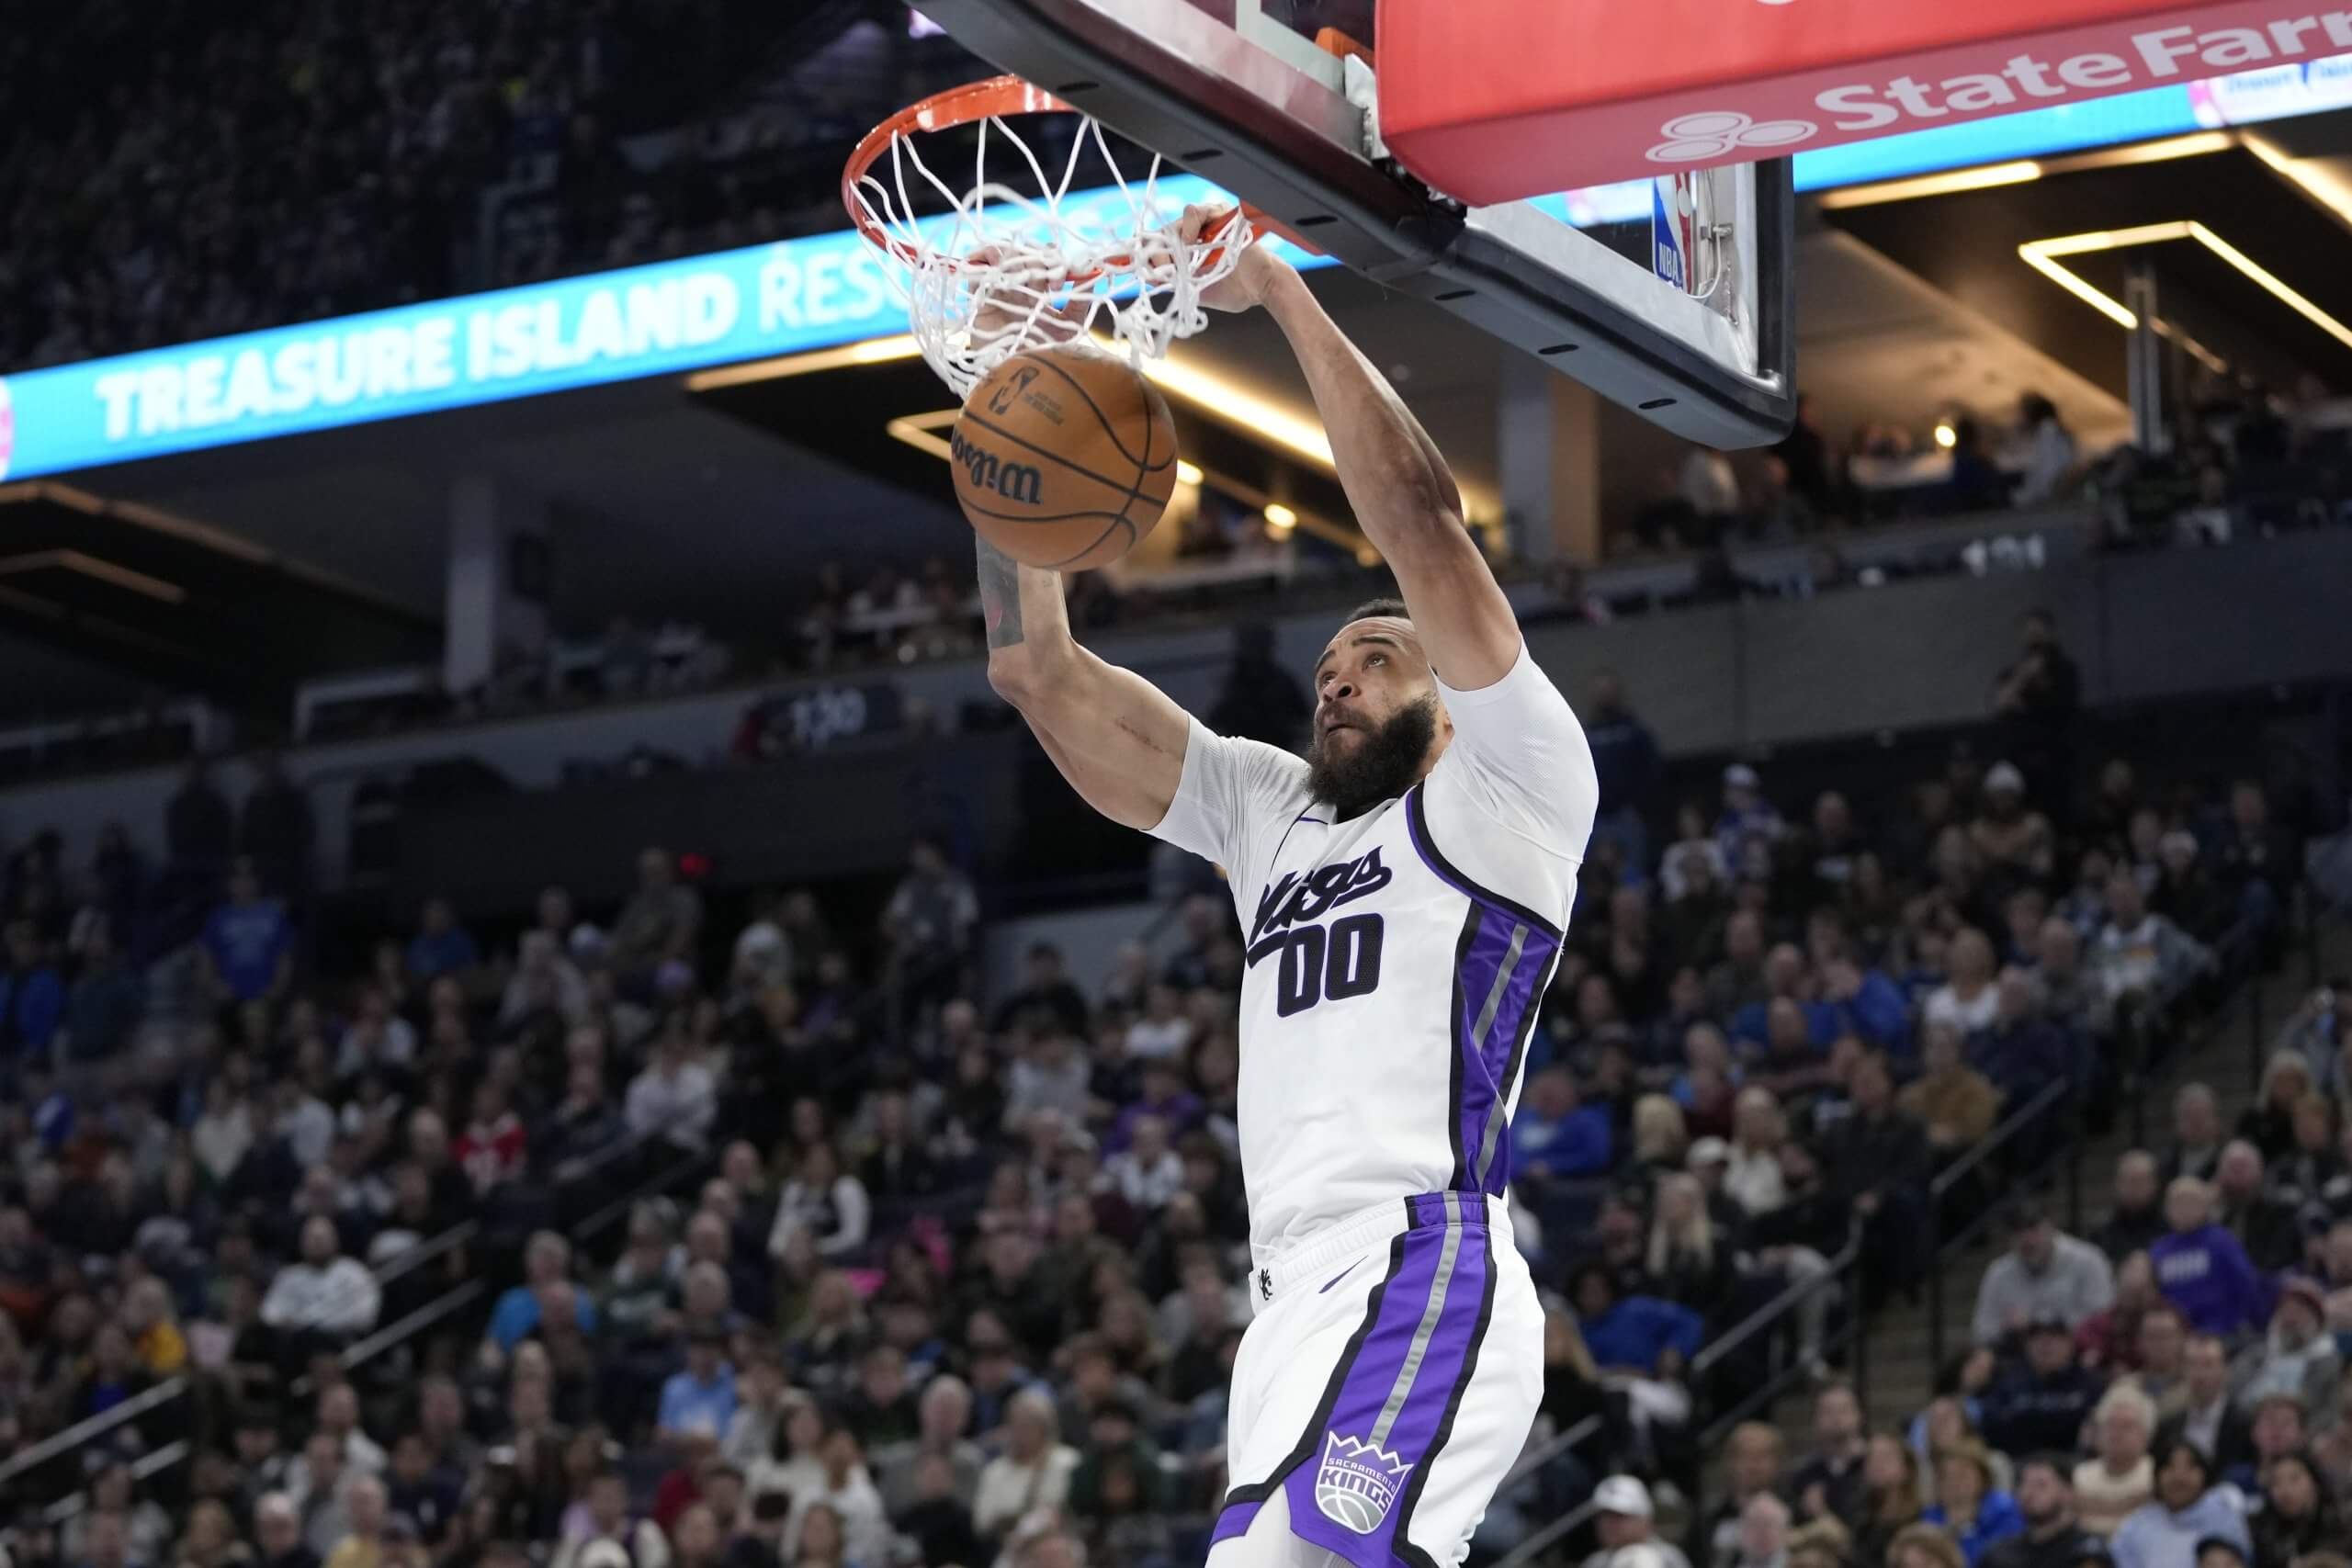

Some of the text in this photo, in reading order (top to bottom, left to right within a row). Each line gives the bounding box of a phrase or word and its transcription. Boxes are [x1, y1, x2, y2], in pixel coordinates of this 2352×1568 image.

[1815, 51, 2131, 131] State
[1658, 242, 1679, 282] NBA
[96, 318, 455, 440] TREASURE
[468, 274, 737, 378] ISLAND
[1277, 913, 1385, 1018] 00
[1319, 1470, 1392, 1515] KINGS
[1328, 1457, 1396, 1493] SACRAMENTO
